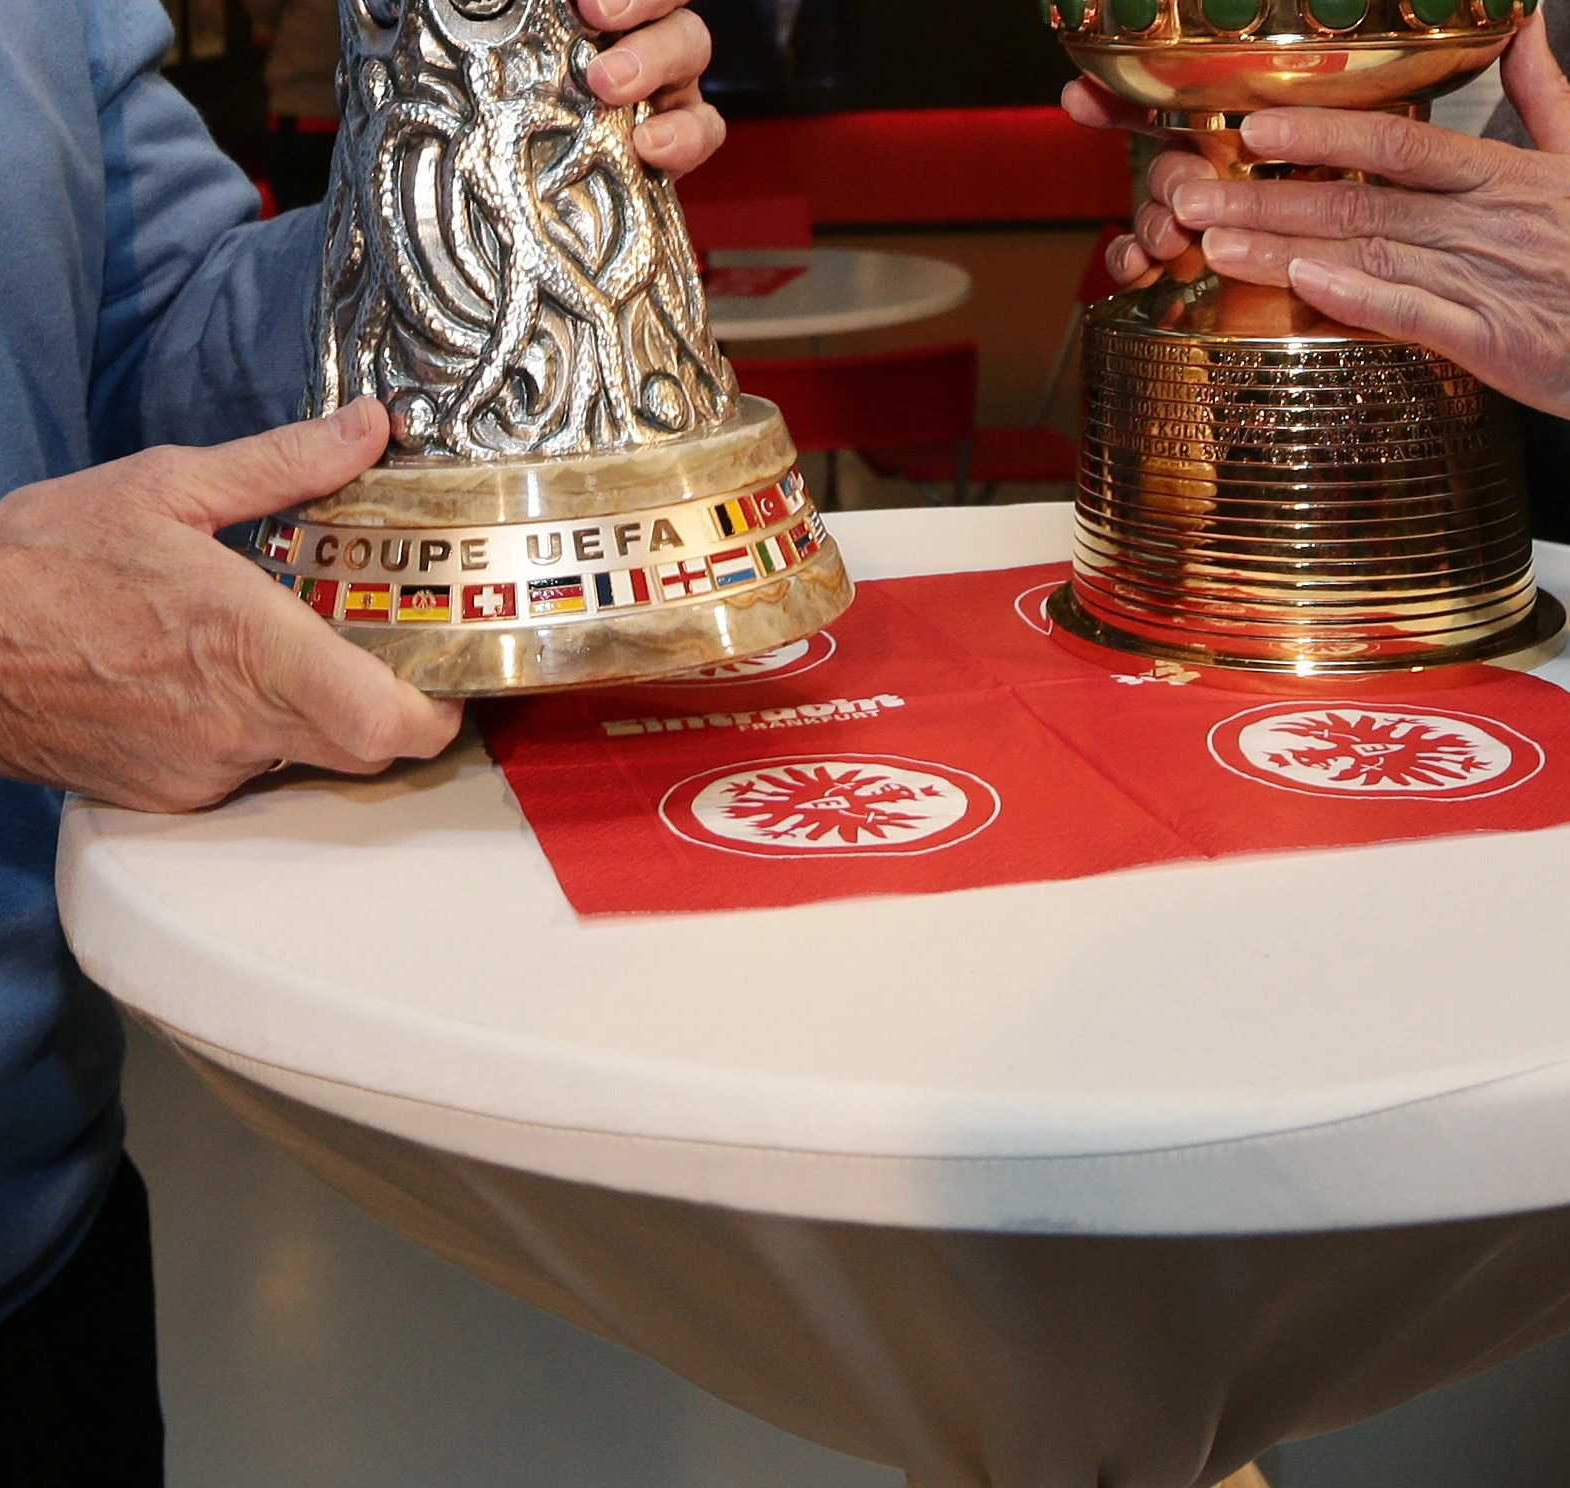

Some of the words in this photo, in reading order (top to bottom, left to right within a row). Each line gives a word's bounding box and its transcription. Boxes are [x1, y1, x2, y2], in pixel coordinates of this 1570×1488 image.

[314, 533, 491, 573] COUPE
[526, 516, 687, 565] UEFA
[599, 692, 906, 737] Eintracht
[738, 708, 880, 732] FRANKFURT
